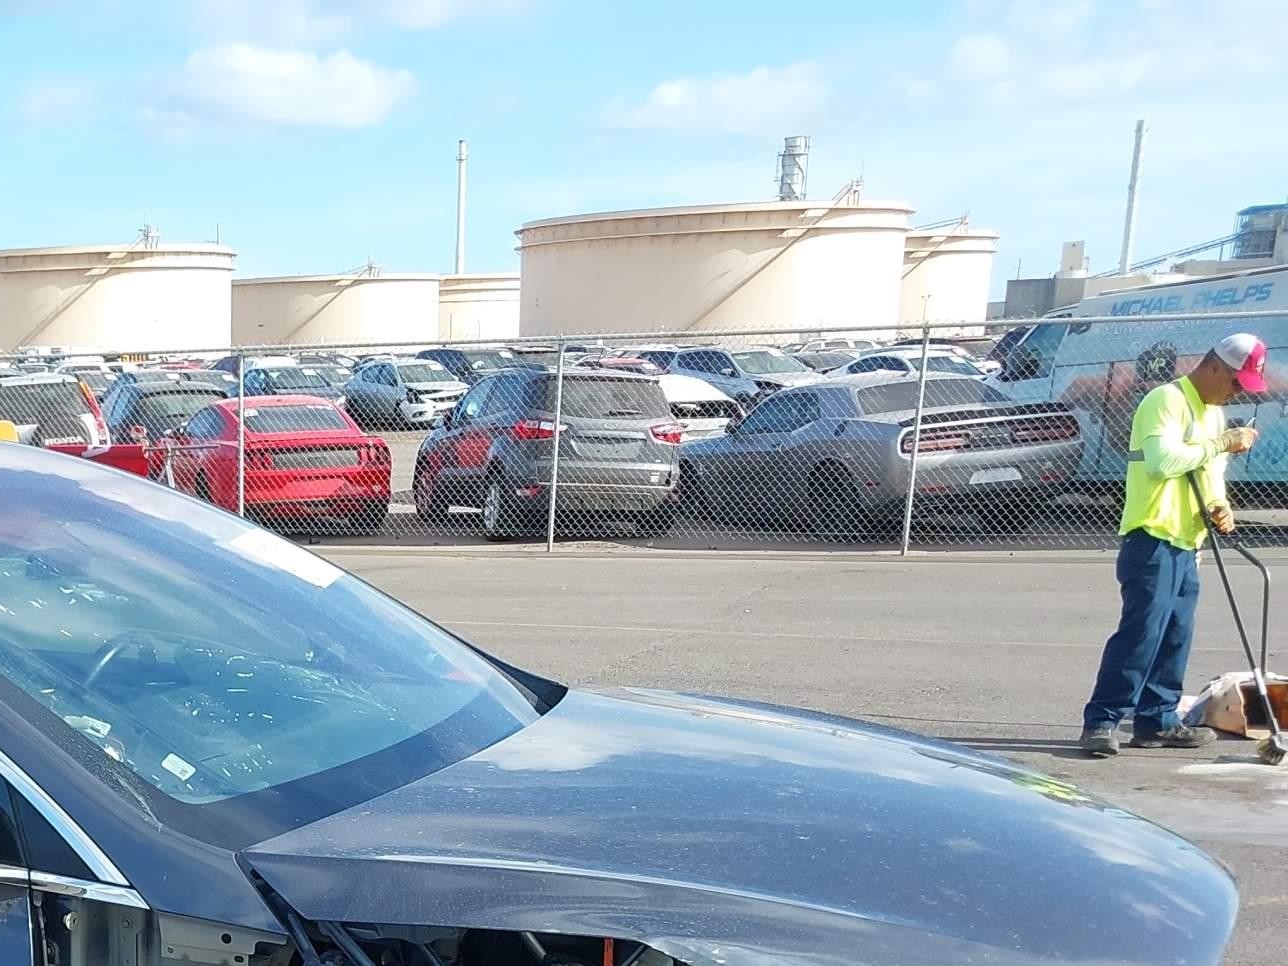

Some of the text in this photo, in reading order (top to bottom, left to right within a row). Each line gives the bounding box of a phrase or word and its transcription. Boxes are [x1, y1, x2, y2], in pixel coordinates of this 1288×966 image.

[1111, 282, 1275, 317] MICHAEL PHELPS
[44, 435, 86, 446] HONDA
